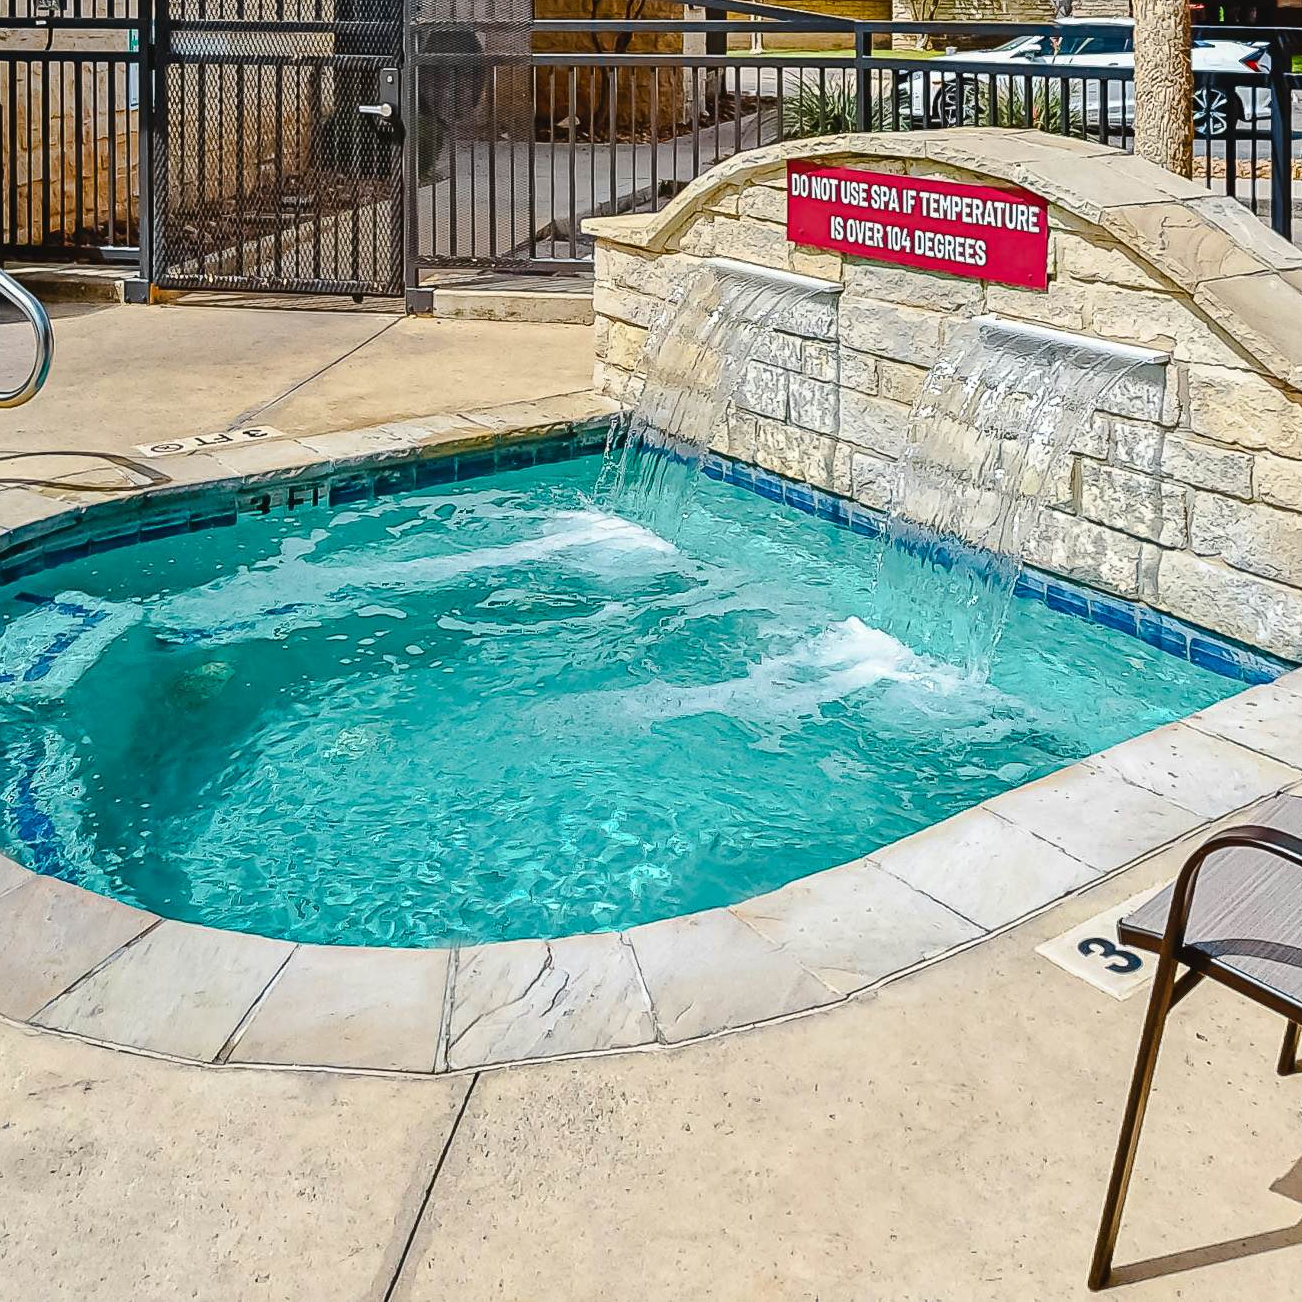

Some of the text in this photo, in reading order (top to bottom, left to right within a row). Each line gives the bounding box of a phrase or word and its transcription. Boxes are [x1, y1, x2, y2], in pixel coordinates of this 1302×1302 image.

[791, 173, 1040, 233] DO NOT USE SPA IF TEMPERATURE
[830, 216, 987, 266] IS OVER 104 DEGREES
[195, 429, 268, 447] 3 FT
[1077, 937, 1143, 973] 3
